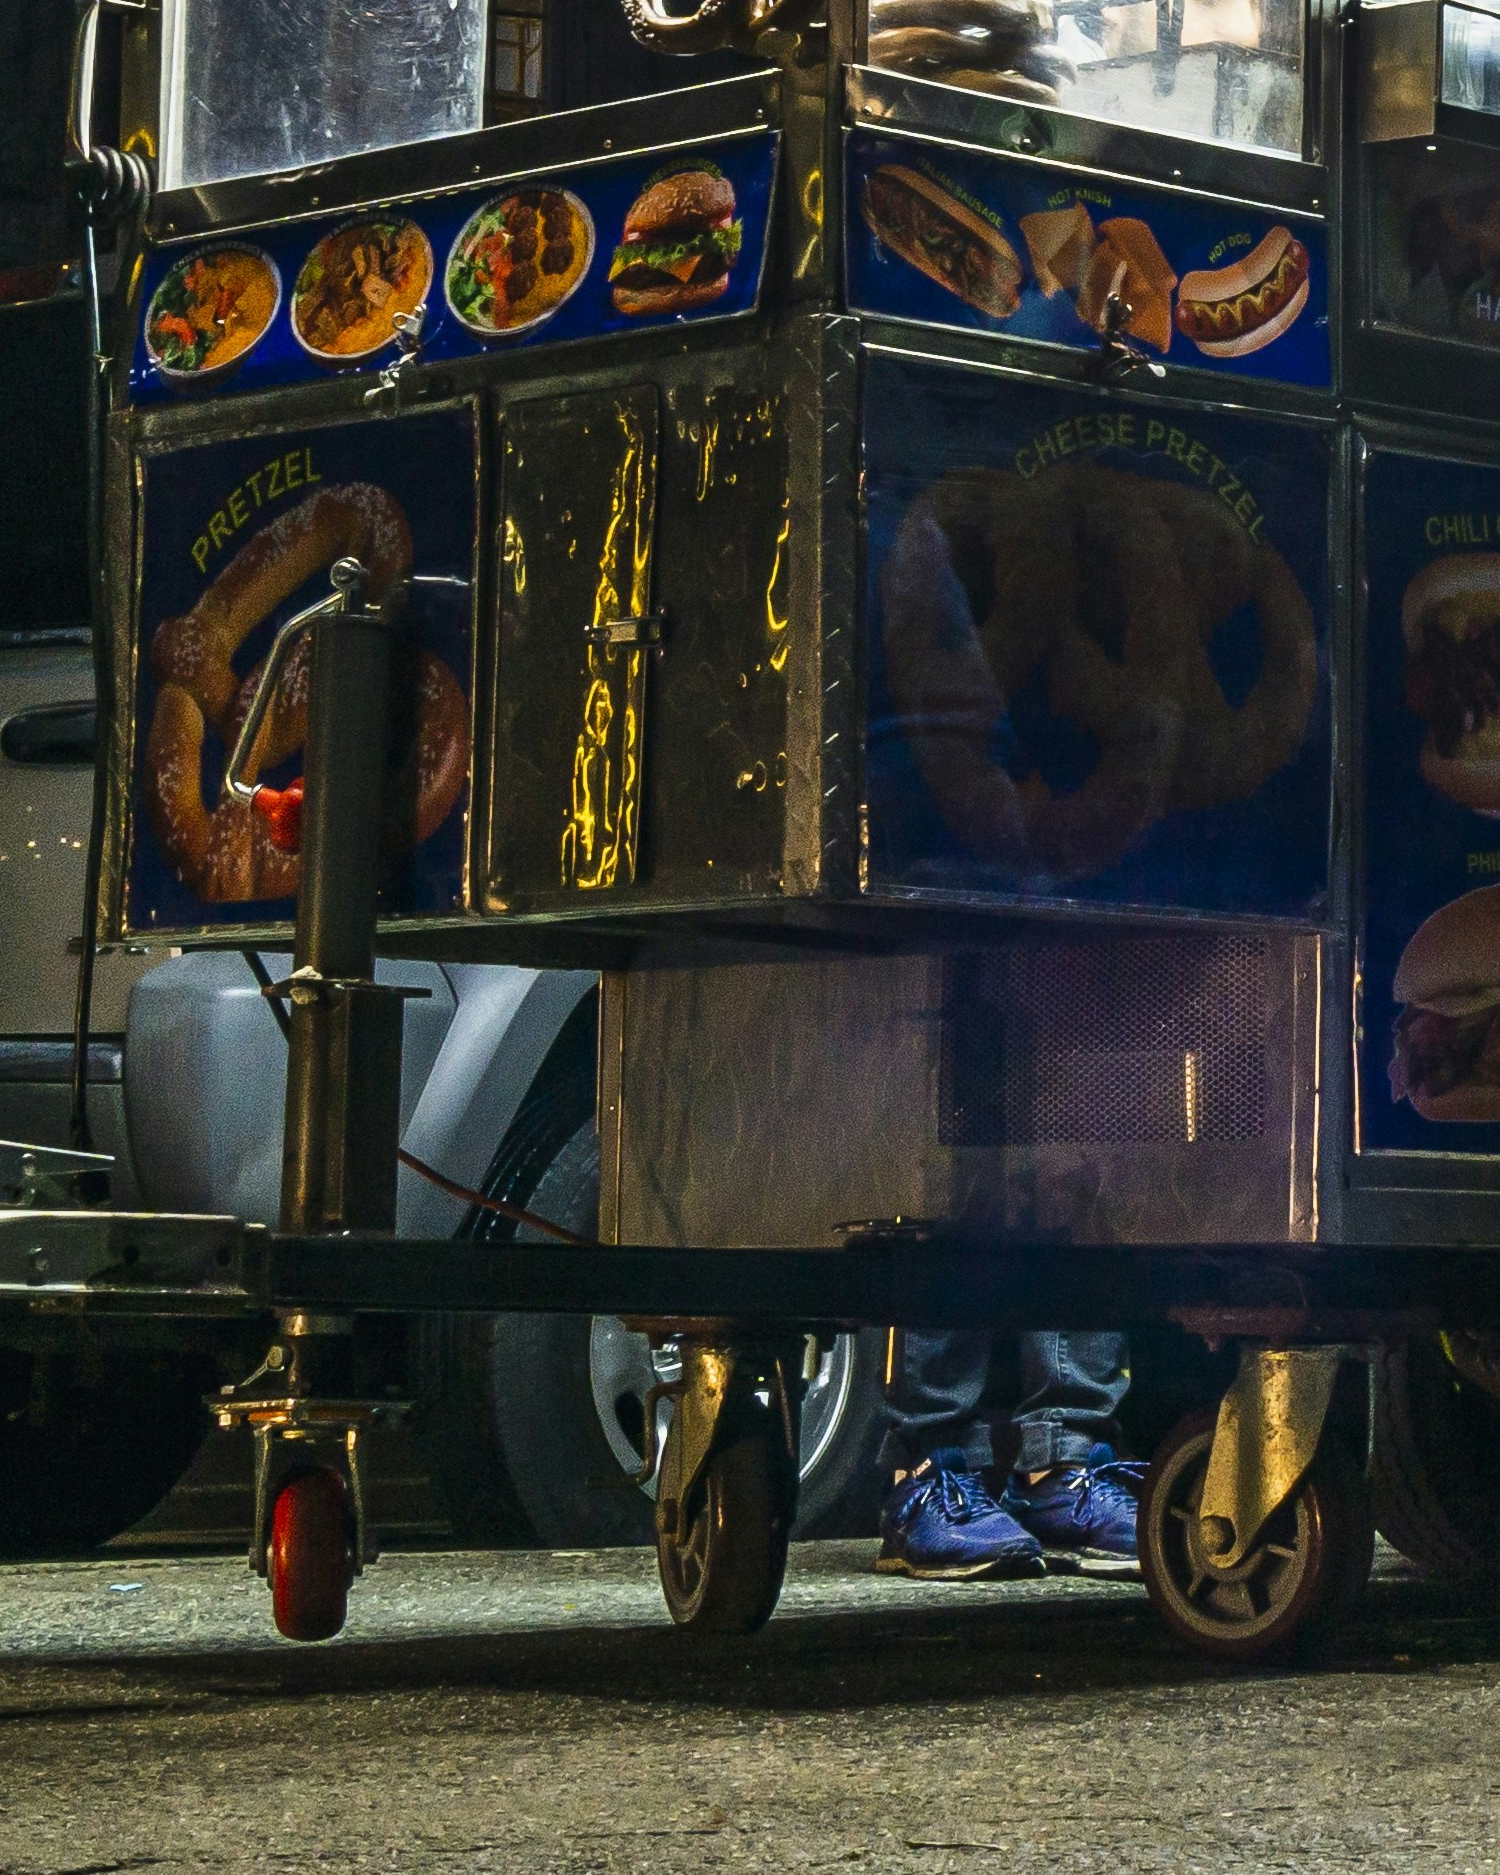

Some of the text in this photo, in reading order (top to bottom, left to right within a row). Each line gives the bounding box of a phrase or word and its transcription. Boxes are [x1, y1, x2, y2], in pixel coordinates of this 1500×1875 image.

[1047, 188, 1070, 208] HOT
[190, 446, 323, 574] PRETZEL
[1015, 412, 1266, 546] CHEESE PRETZEL
[1425, 514, 1490, 546] CHILI
